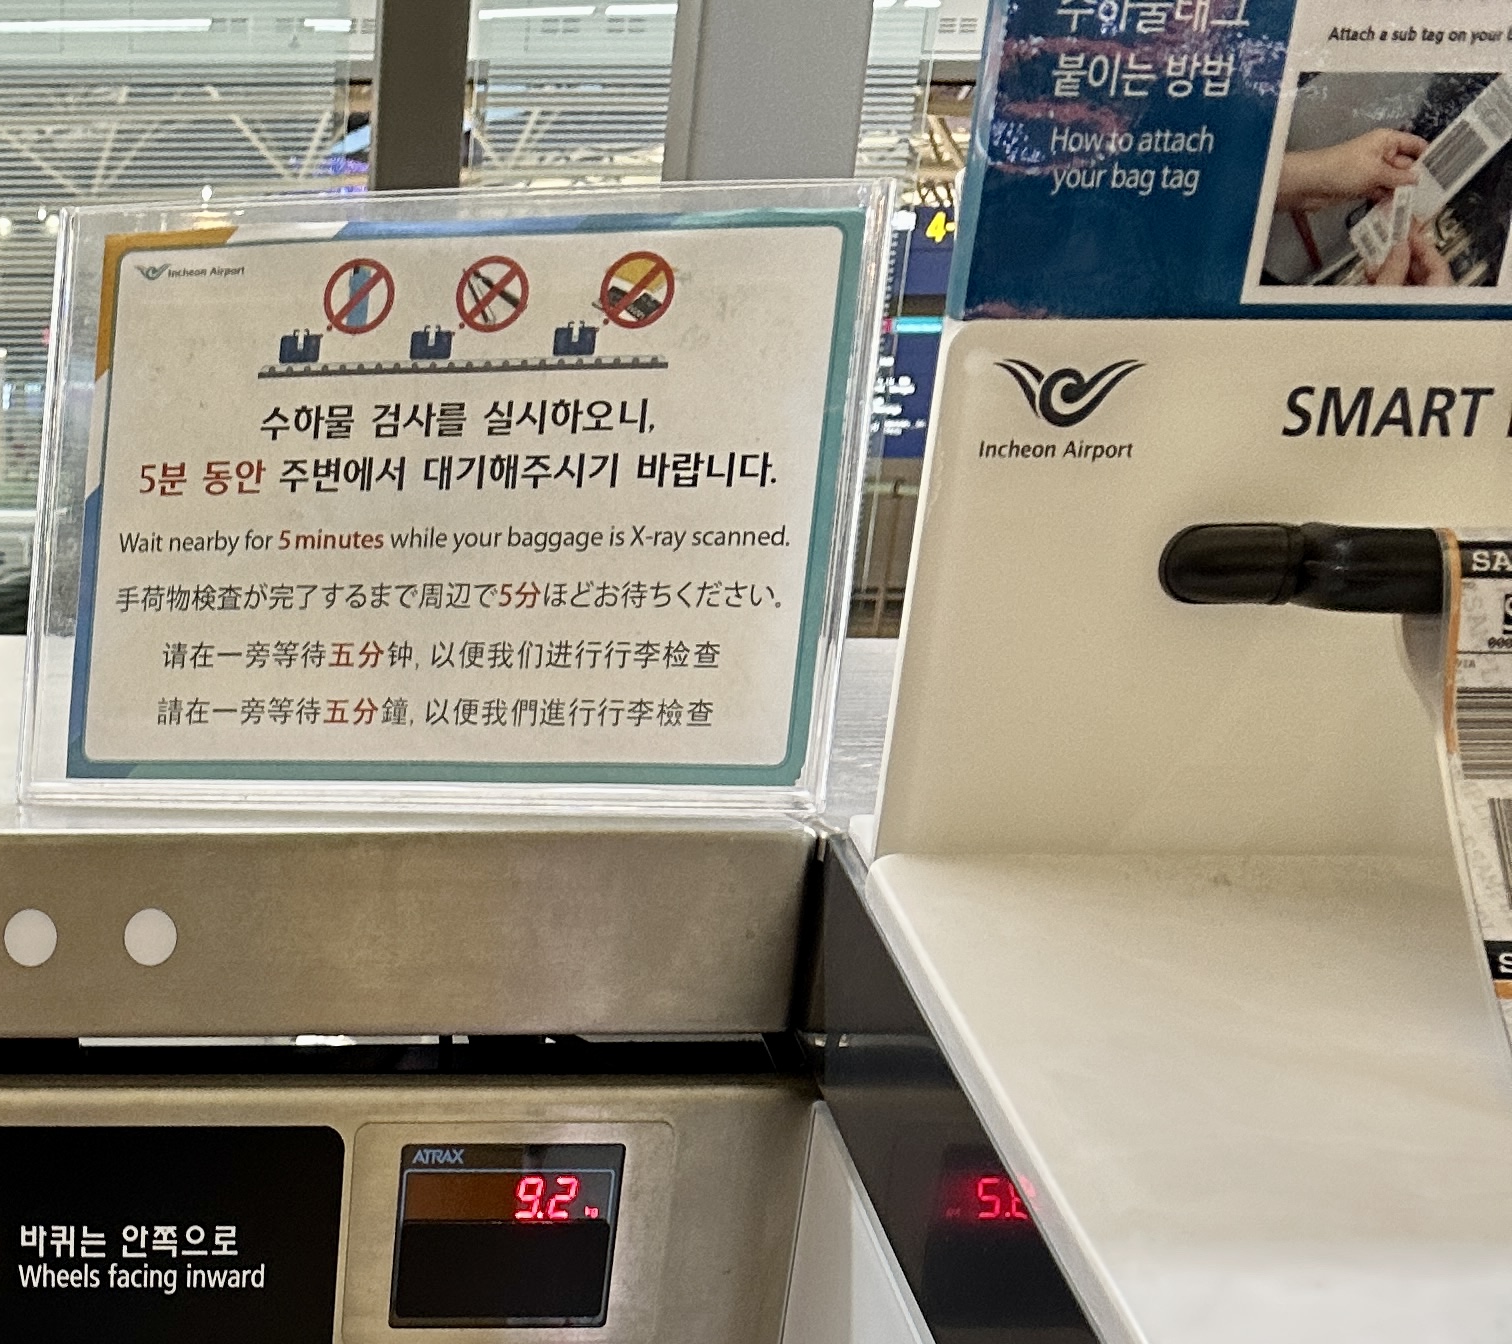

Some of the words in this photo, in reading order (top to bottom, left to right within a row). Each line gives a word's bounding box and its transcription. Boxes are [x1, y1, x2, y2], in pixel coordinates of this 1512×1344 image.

[1328, 25, 1376, 42] Attach
[1379, 29, 1388, 41] a
[1391, 26, 1418, 42] sub
[1422, 28, 1444, 45] tag
[1448, 31, 1467, 42] on
[1470, 30, 1503, 46] your
[1051, 51, 1157, 98] 붙이는
[1165, 52, 1238, 98] 방법
[1050, 126, 1107, 152] How
[1109, 130, 1134, 152] to
[1138, 125, 1215, 153] attach
[1051, 166, 1107, 196] your
[1110, 162, 1156, 196] bag
[1161, 166, 1201, 196] tag
[168, 267, 207, 278] Incheon
[210, 265, 245, 278] Airport
[259, 403, 355, 441] 수하물
[371, 401, 467, 439] 검사를
[484, 398, 655, 437] 실시하오니,
[1281, 386, 1496, 438] SMART
[978, 439, 1057, 459] Incheon
[1063, 439, 1134, 463] Airport
[139, 461, 188, 496] 5분
[202, 458, 267, 496] 동안
[279, 455, 406, 494] 주변에서
[422, 452, 620, 490] 대기해주시기
[636, 451, 778, 488] 바랍니다.
[119, 531, 163, 553] Wait
[169, 530, 240, 557] nearby
[245, 528, 274, 550] for
[278, 529, 292, 550] 5
[295, 528, 385, 550] minutes
[390, 526, 448, 549] while
[453, 529, 503, 553] your
[507, 525, 604, 553] baggage
[609, 525, 625, 547] is
[630, 525, 687, 552] X-ray
[691, 524, 790, 547] scanned.
[1471, 551, 1512, 572] SA
[115, 581, 782, 613] 手荷物検査が完了するまで周辺で5分ほどお待ちください。
[412, 1148, 464, 1165] ATRAX
[515, 1176, 578, 1219] 9.2
[20, 1224, 107, 1258] 바퀴는
[122, 1224, 239, 1258] 안쪽으로
[18, 1263, 100, 1289] Wheels
[107, 1263, 178, 1295] facing
[186, 1263, 266, 1289] inward
